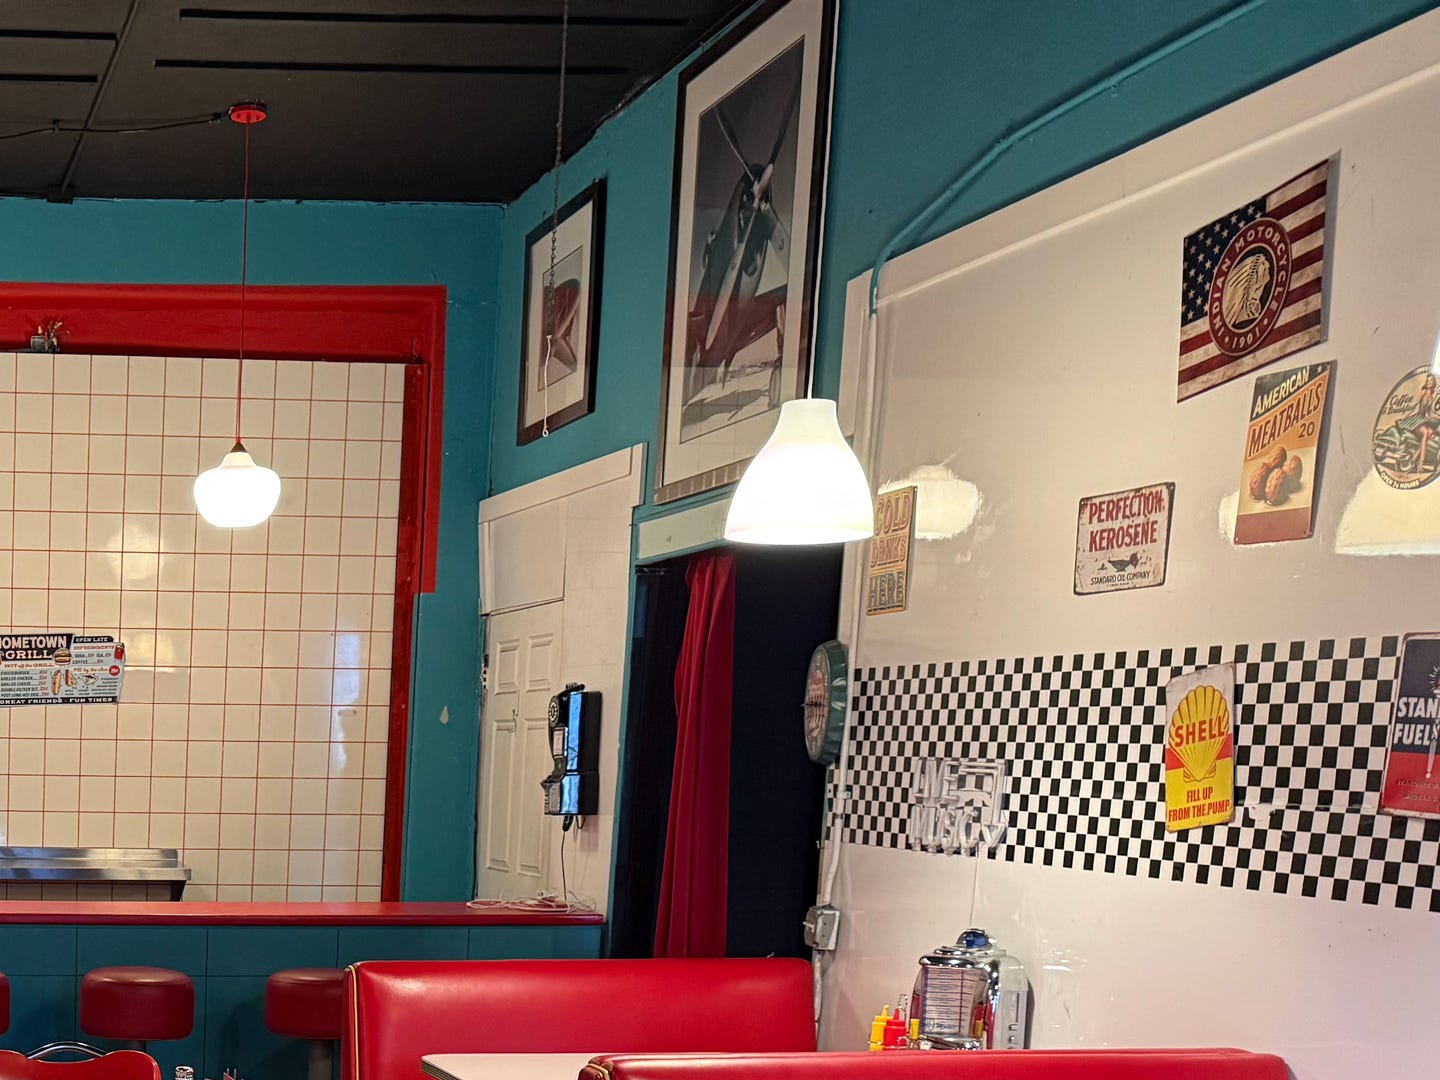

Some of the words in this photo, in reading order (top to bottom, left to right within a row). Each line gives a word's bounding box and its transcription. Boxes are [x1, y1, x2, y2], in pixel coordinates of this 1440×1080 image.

[1212, 258, 1231, 337] INDIAN
[1235, 226, 1287, 312] MOTORCYCLE
[1232, 327, 1259, 349] 1901
[1252, 366, 1310, 418] AMERICAN
[1248, 382, 1323, 457] MEATBALLS
[1298, 421, 1315, 438] 20
[1380, 471, 1392, 486] OPEN
[875, 493, 910, 536] COLD
[1088, 490, 1164, 524] PERFECTION
[1089, 520, 1158, 552] KEROSENE
[868, 570, 904, 612] HERE
[1090, 574, 1116, 585] STANDARD
[1117, 573, 1126, 582] OIL
[1127, 570, 1151, 581] COMPANY
[5, 650, 53, 660] GRILL
[1397, 697, 1440, 719] STAN
[1175, 716, 1225, 748] SHELL
[912, 758, 960, 801] LIVE
[1186, 789, 1201, 804] FILL
[1202, 786, 1213, 800] UP
[1168, 807, 1190, 822] FROM
[1192, 804, 1205, 818] THE
[1207, 799, 1230, 815] PUMP
[909, 805, 980, 849] MUSIC
